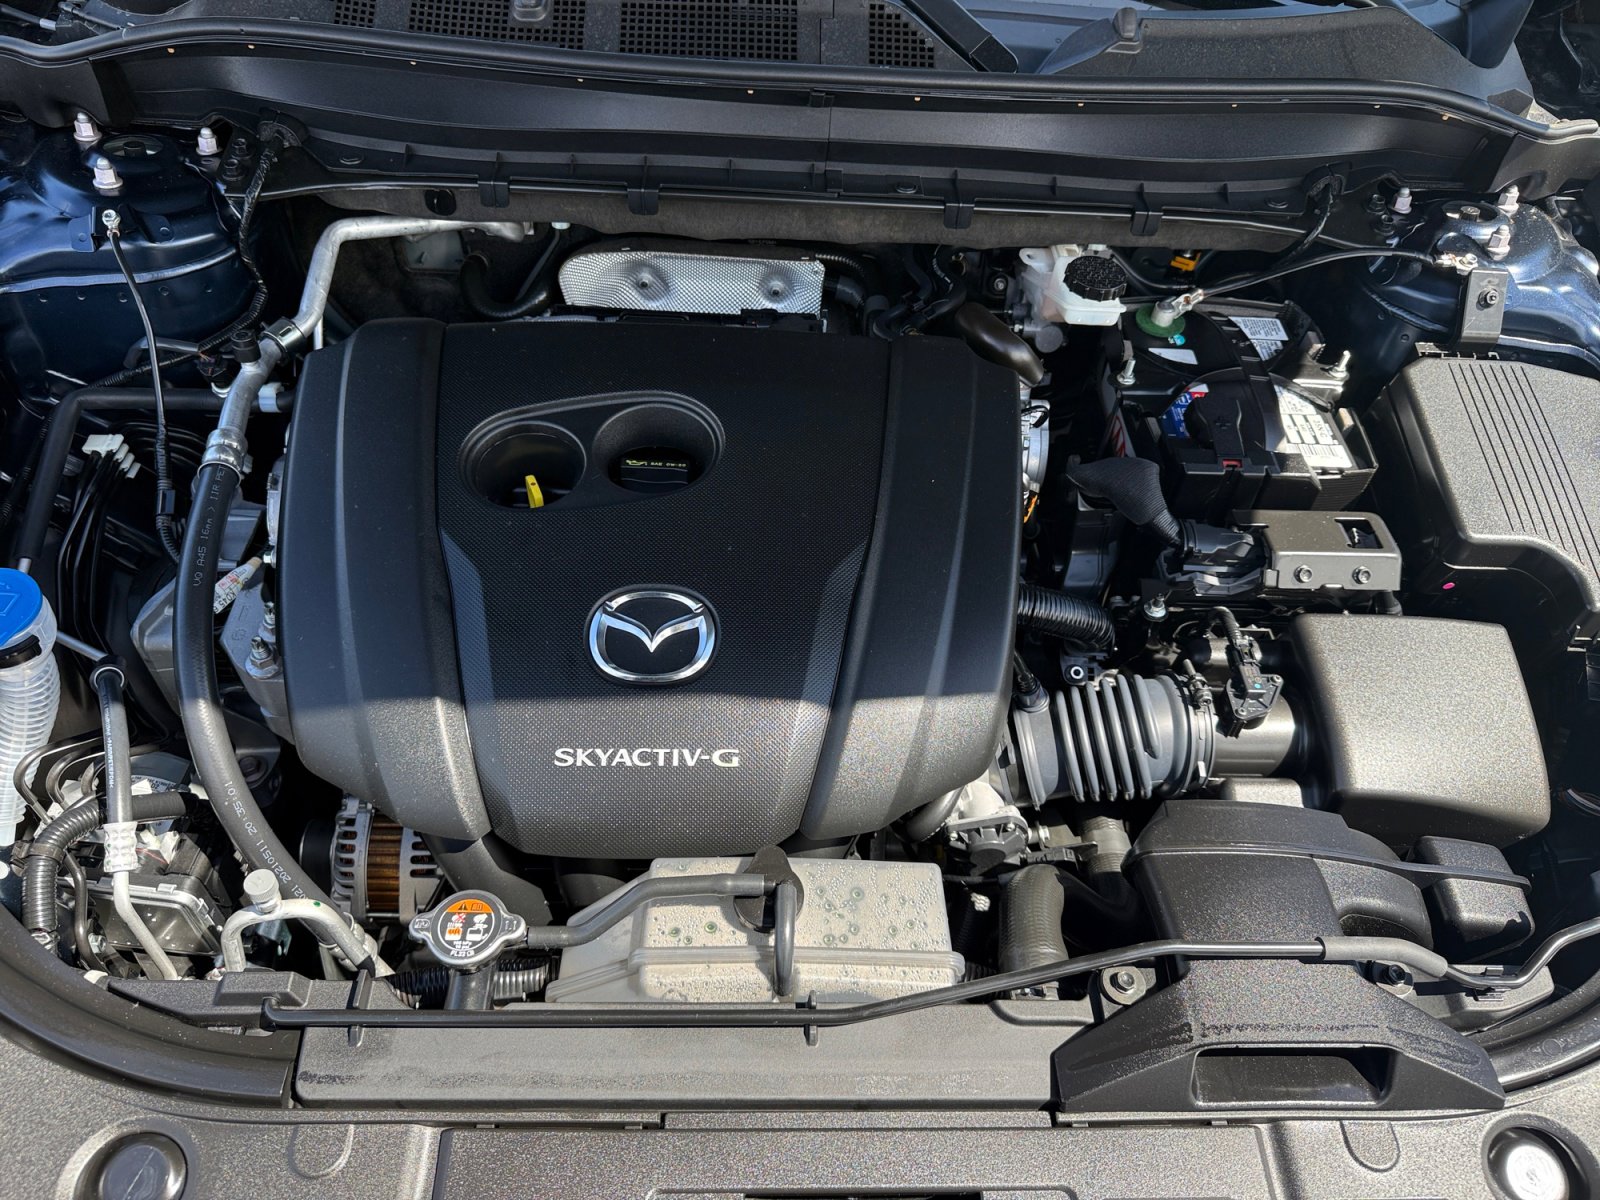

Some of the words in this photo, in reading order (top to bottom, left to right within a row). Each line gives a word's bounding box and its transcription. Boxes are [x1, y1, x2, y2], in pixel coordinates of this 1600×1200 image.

[553, 748, 740, 768] SKYACTIV-G
[224, 781, 258, 836] 20:35:01
[256, 839, 292, 884] 20210511
[291, 884, 309, 900] 021
